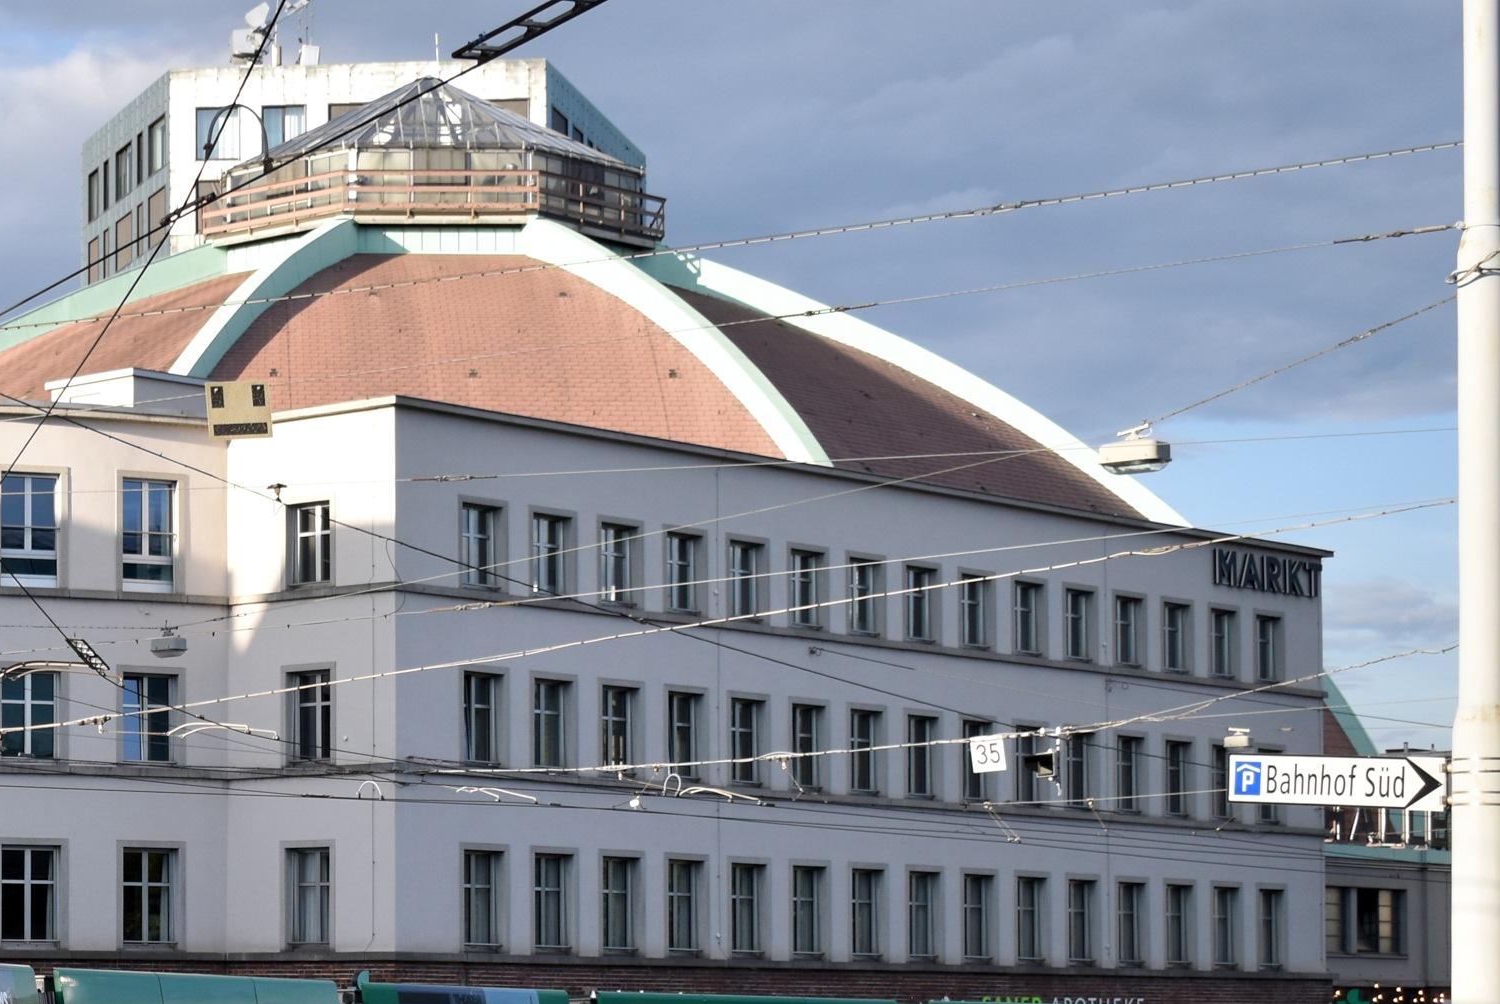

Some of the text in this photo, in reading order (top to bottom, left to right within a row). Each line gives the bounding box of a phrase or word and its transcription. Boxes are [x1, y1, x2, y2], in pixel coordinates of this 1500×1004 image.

[1213, 547, 1322, 598] MARKT
[976, 742, 1001, 765] 35
[1266, 763, 1357, 796] Bahnhof
[1365, 766, 1405, 798] Süd
